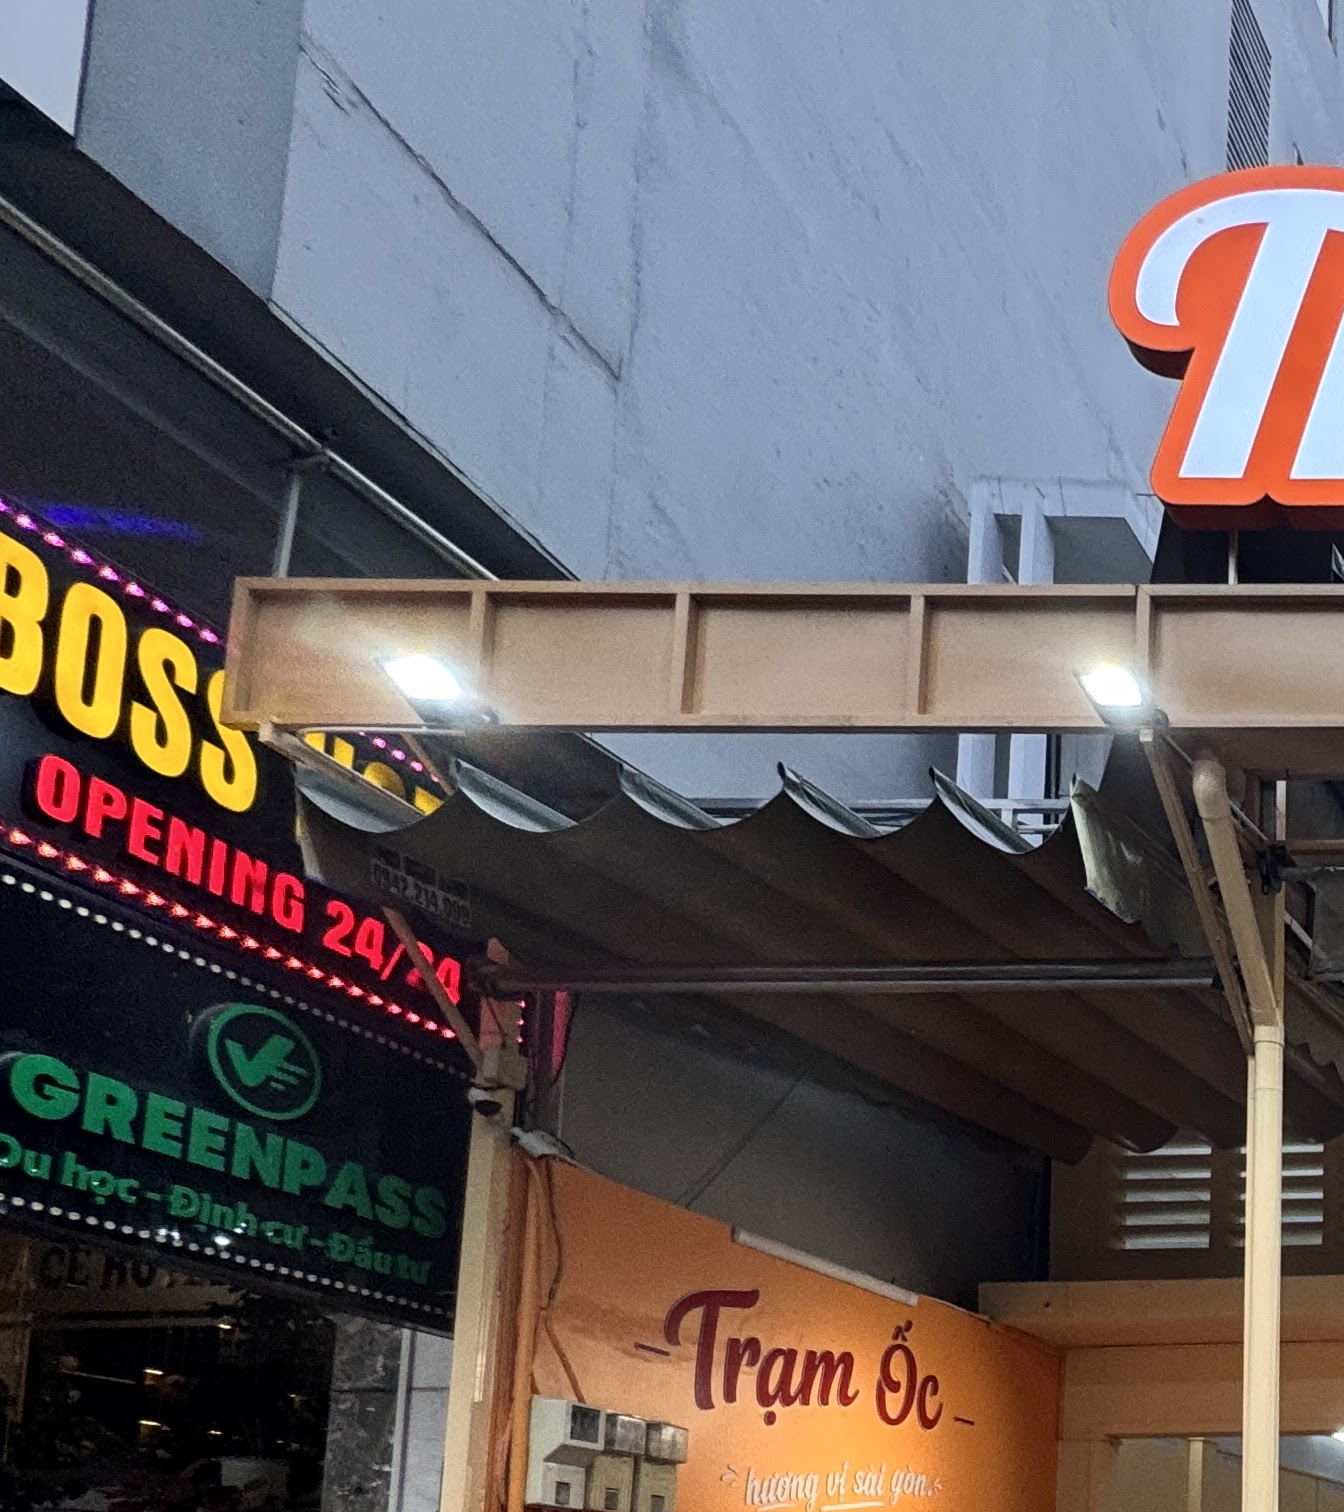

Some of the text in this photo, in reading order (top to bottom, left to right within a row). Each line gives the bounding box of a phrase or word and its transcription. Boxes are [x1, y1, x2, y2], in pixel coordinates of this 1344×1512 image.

[0, 530, 257, 812] BOSS
[35, 752, 305, 932] OPENING
[8, 1053, 448, 1239] GREENPASS
[60, 1150, 141, 1204] học
[664, 1289, 944, 1431] Trạm Ốc
[745, 1466, 818, 1512] hương
[826, 1462, 848, 1503] vị
[853, 1469, 885, 1496] sài
